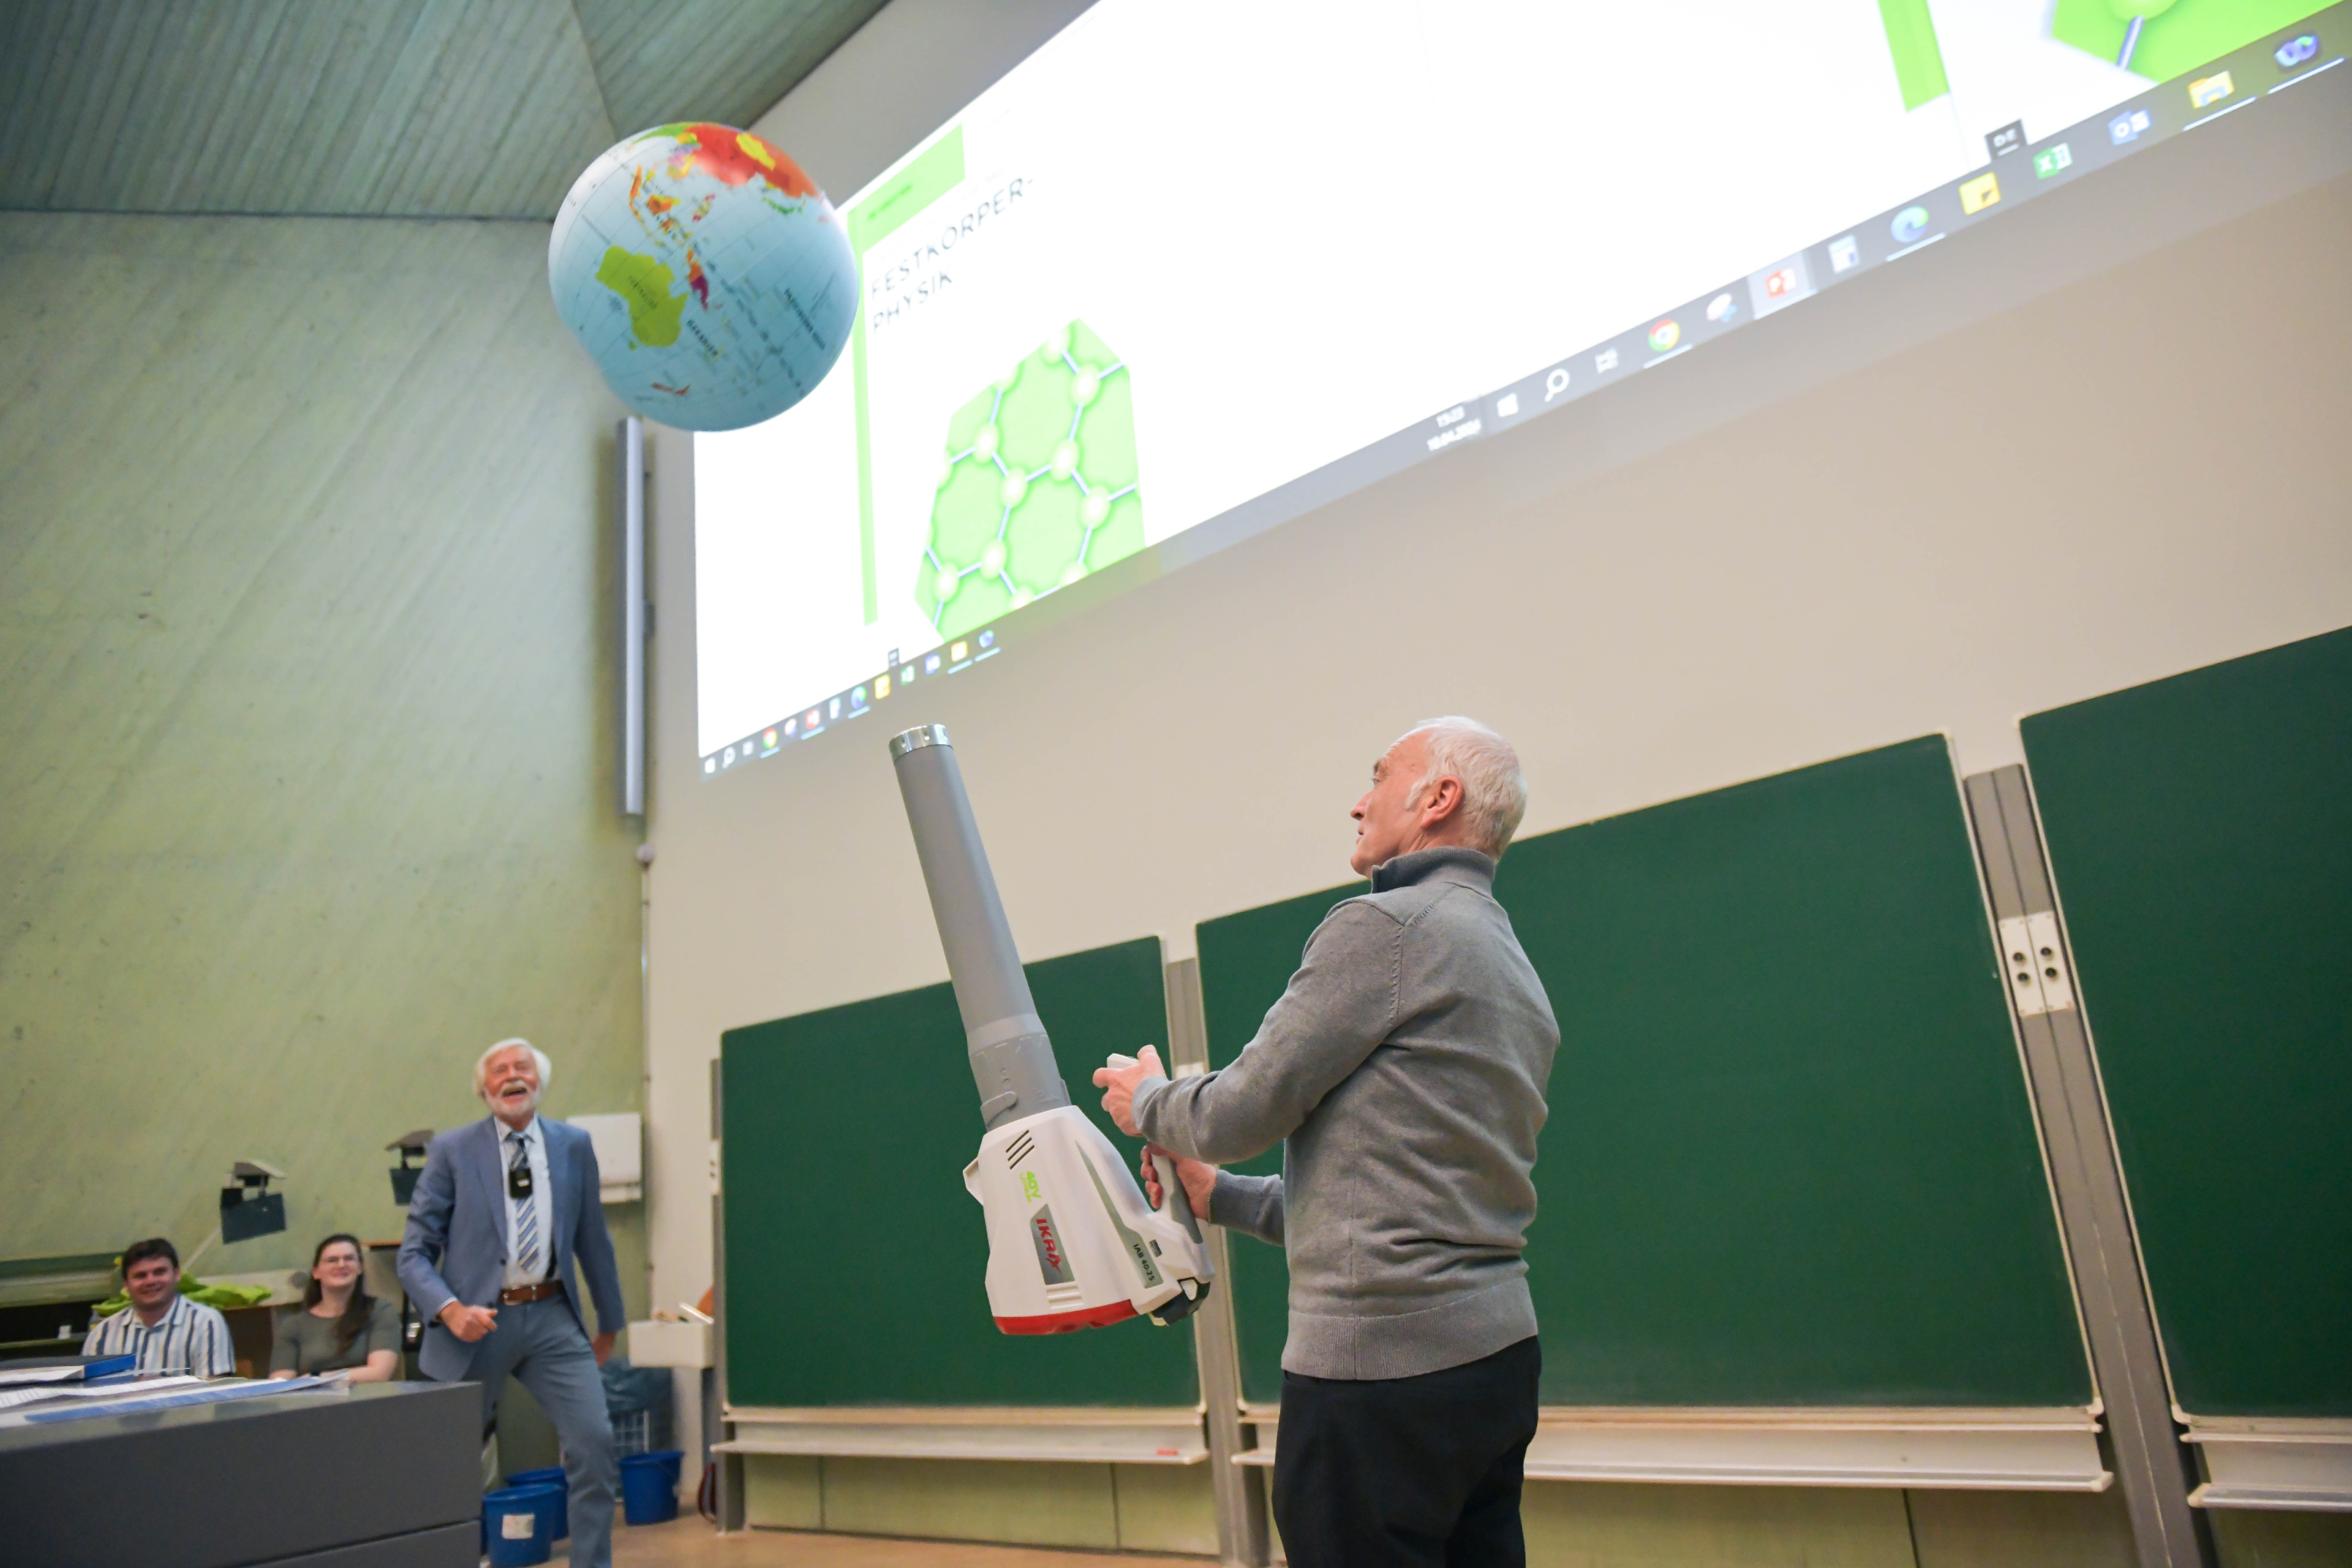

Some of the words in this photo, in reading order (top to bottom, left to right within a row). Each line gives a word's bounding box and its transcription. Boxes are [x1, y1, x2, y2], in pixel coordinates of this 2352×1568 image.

[873, 265, 952, 335] PHYSIK
[1026, 1170, 1042, 1199] 40V
[1036, 1218, 1061, 1274] IKRA
[1133, 1243, 1144, 1258] IAB
